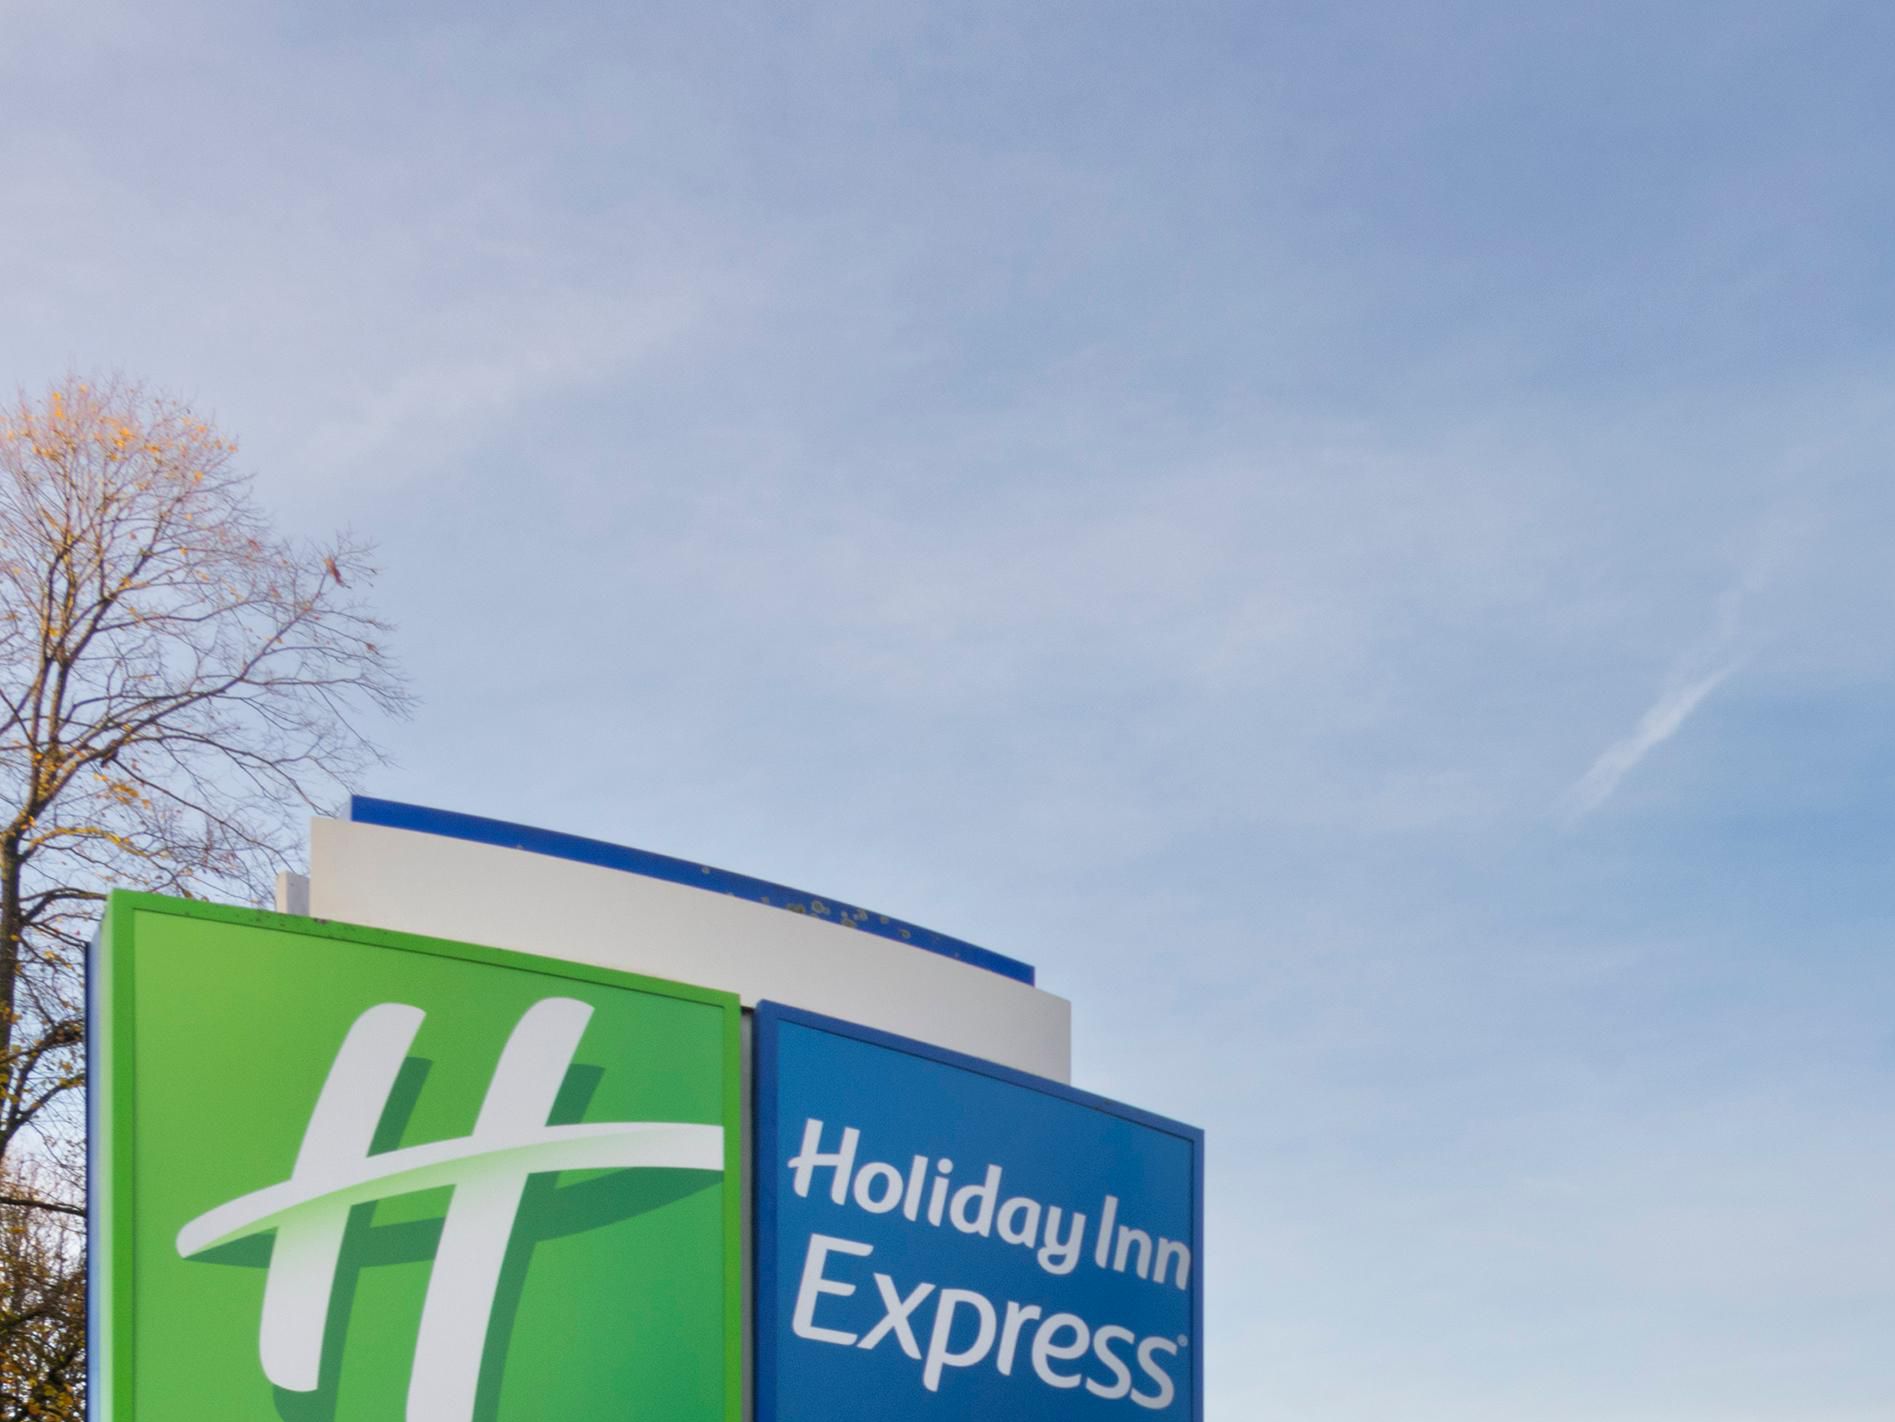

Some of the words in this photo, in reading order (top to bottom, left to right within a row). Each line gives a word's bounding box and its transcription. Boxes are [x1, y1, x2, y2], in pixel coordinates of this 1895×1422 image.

[787, 1118, 1087, 1275] Holiday
[1095, 1194, 1192, 1291] Inn
[792, 1232, 1176, 1410] Express
